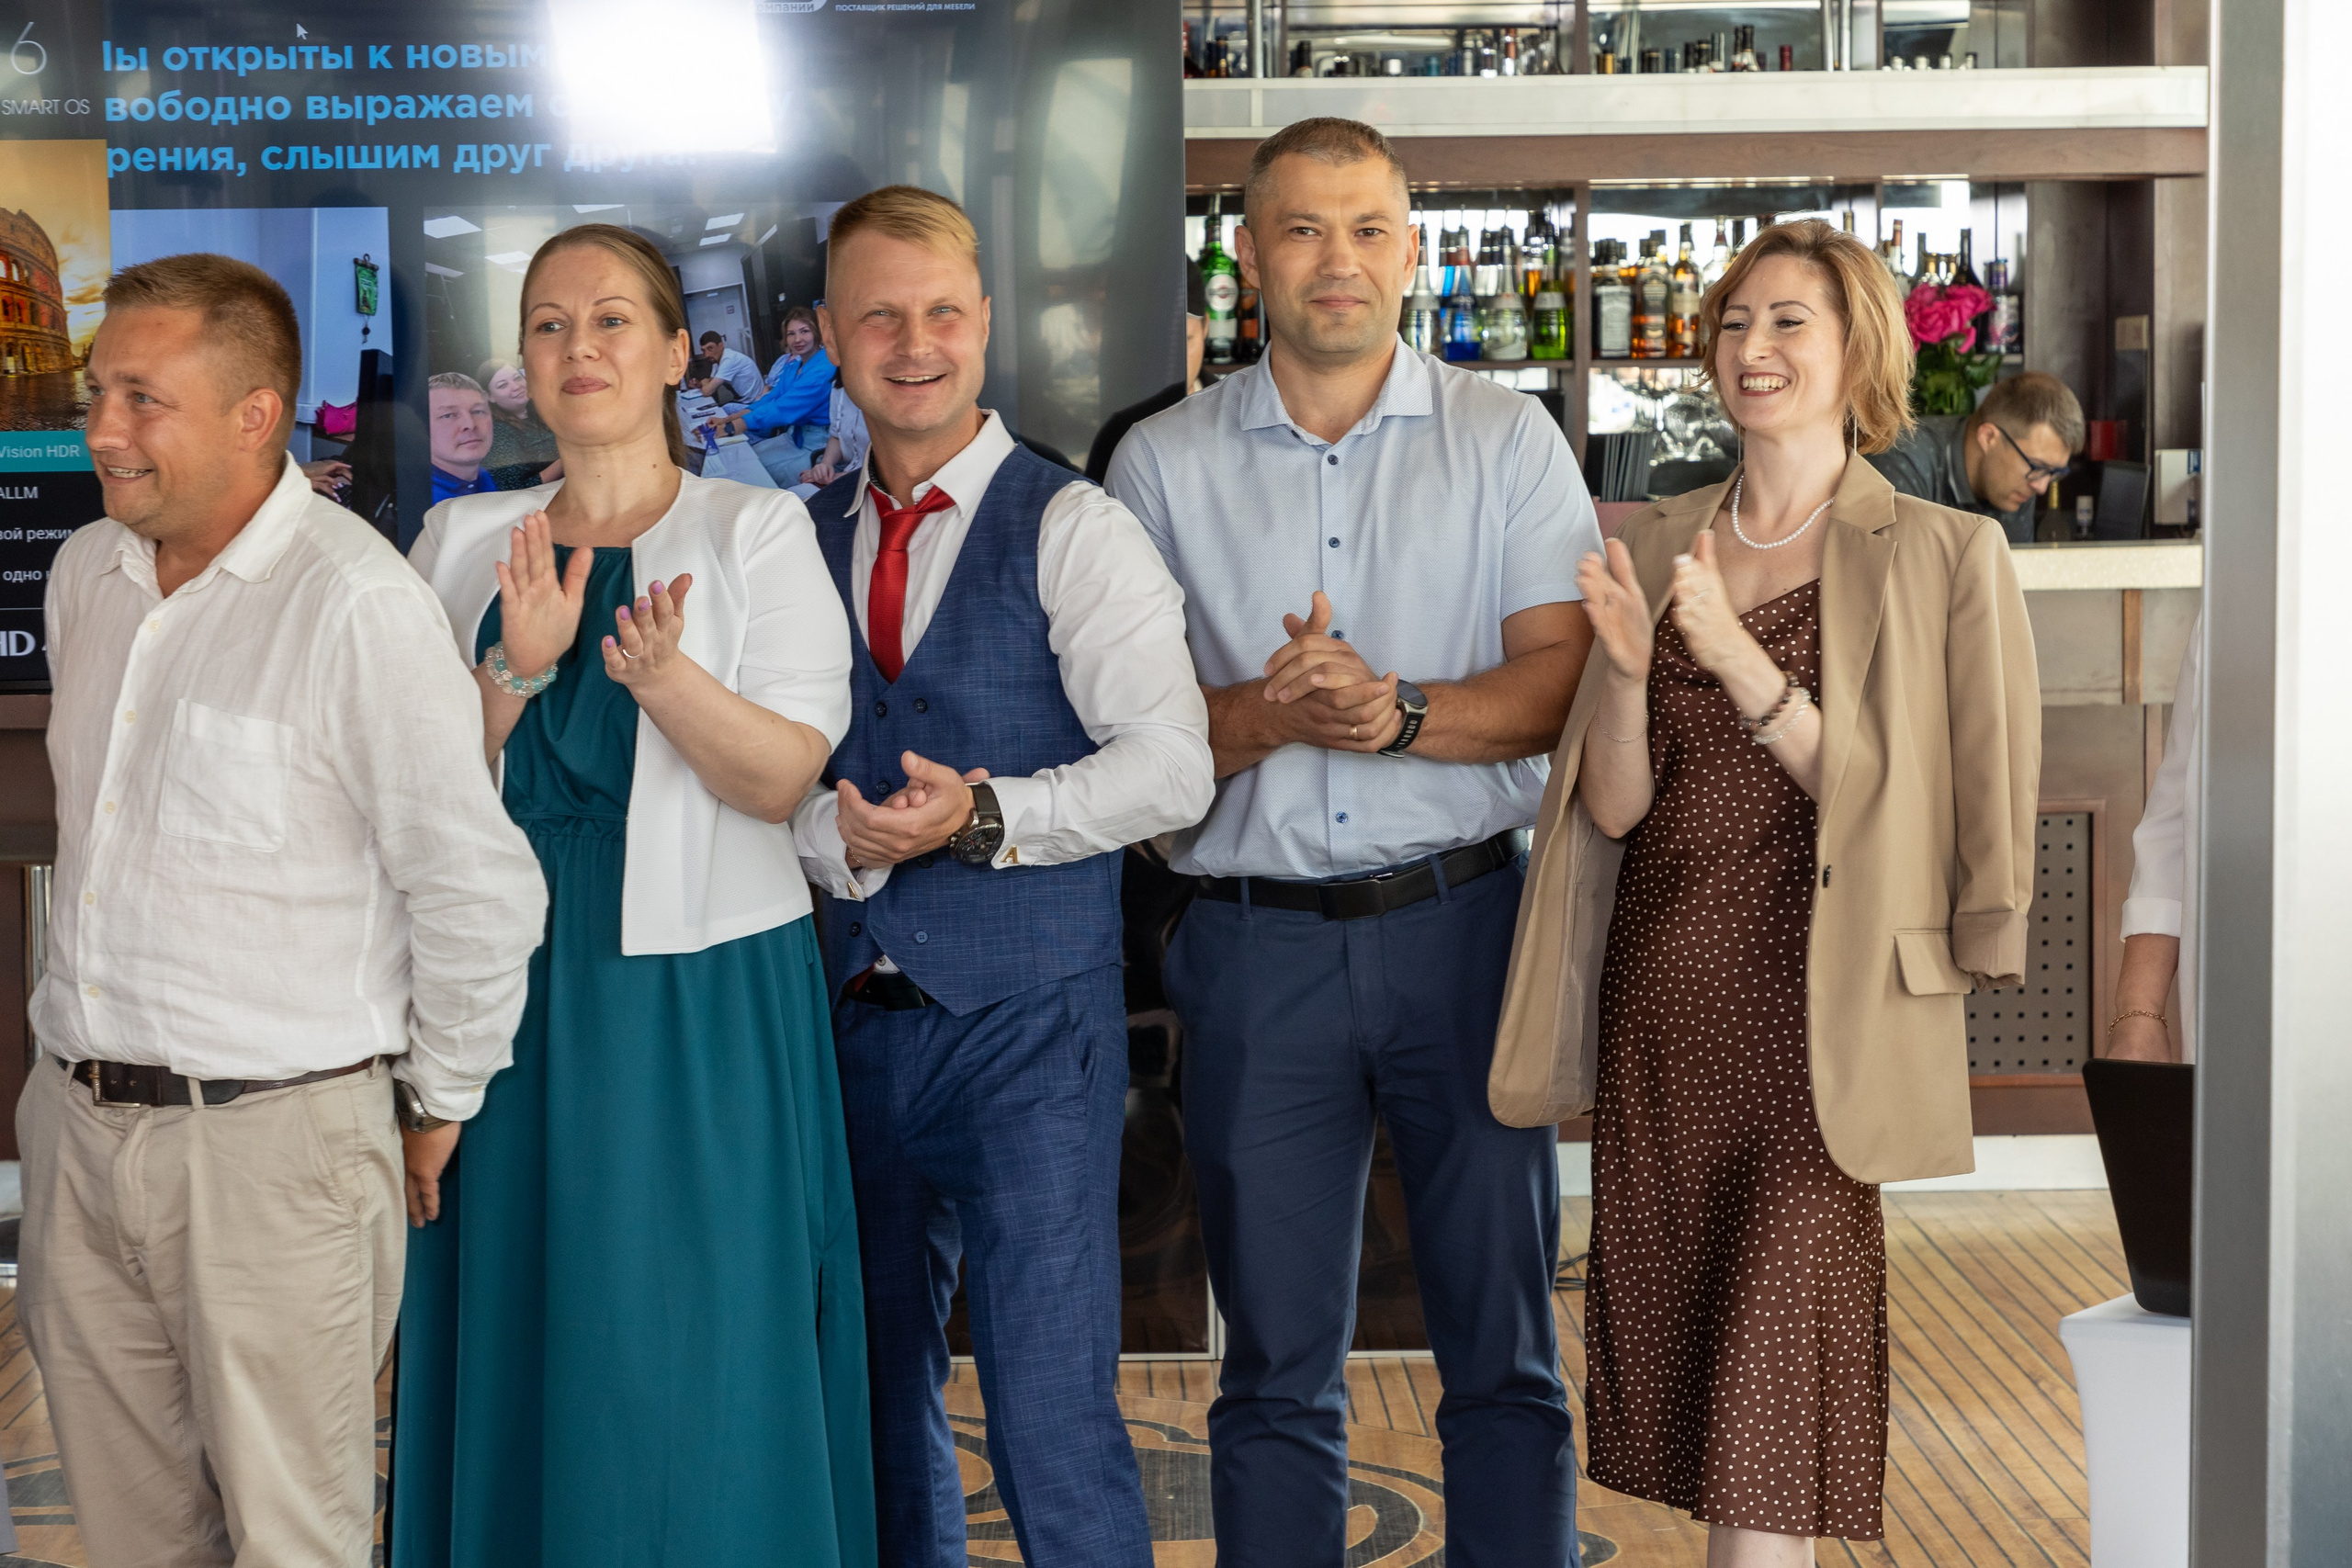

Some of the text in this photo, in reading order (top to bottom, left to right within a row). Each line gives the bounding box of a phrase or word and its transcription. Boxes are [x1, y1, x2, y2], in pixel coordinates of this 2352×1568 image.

[754, 3, 815, 13] омпании
[835, 4, 885, 12] ПОСТАВЩИК
[887, 3, 925, 11] РЕШЕНИЙ
[11, 21, 48, 75] 6
[163, 45, 354, 77] открыты
[368, 45, 394, 69] к
[406, 44, 548, 69] новым
[1, 98, 91, 116] SMART OS
[105, 89, 292, 126] вободно
[306, 93, 534, 126] выражаем
[107, 146, 247, 178] рения,
[261, 144, 440, 172] слышим
[453, 143, 551, 175] друг
[46, 444, 81, 458] HDR
[3, 570, 42, 582] одно
